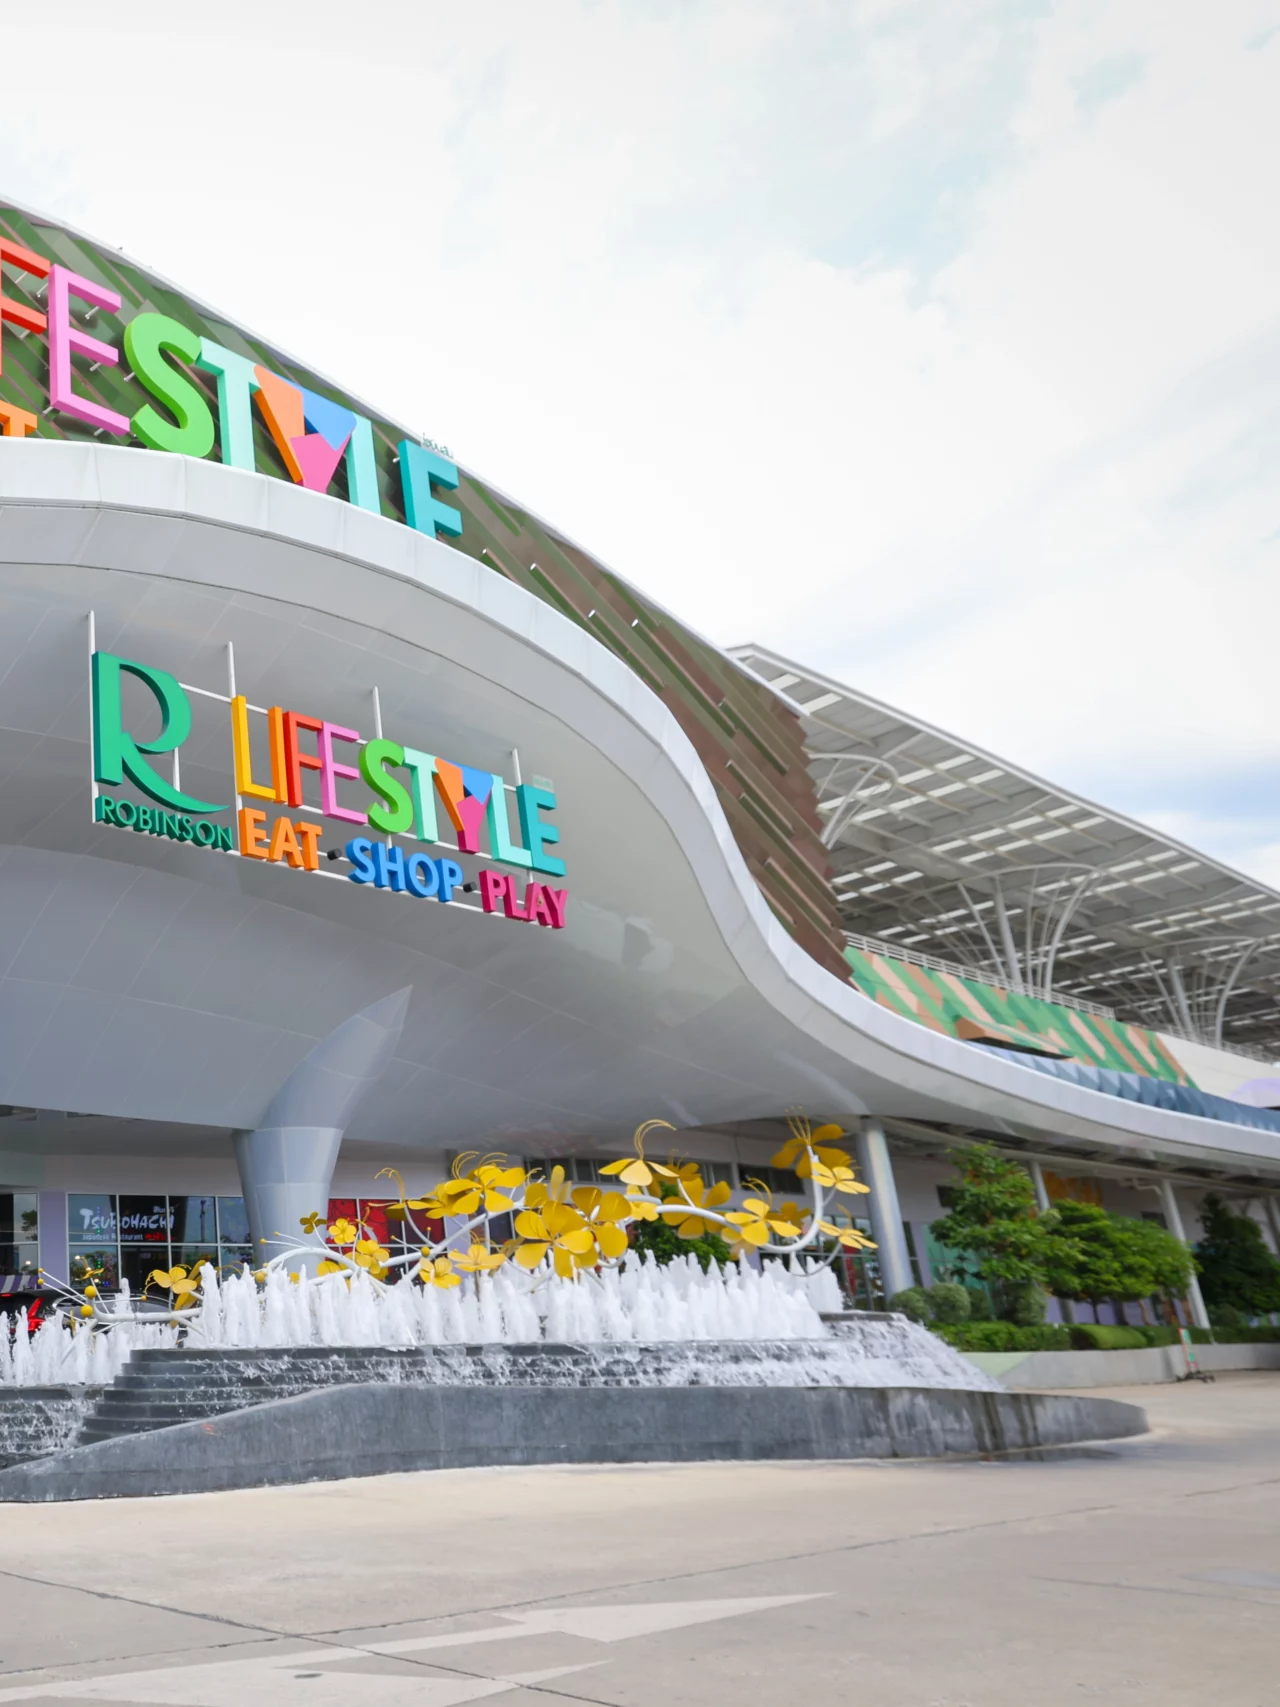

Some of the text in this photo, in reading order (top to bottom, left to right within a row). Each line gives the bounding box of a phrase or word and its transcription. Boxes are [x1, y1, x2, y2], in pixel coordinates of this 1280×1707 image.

[94, 794, 233, 852] ROBINSON
[232, 694, 566, 877] LIFESTYLE
[239, 807, 569, 929] EAT SHOP PLAY
